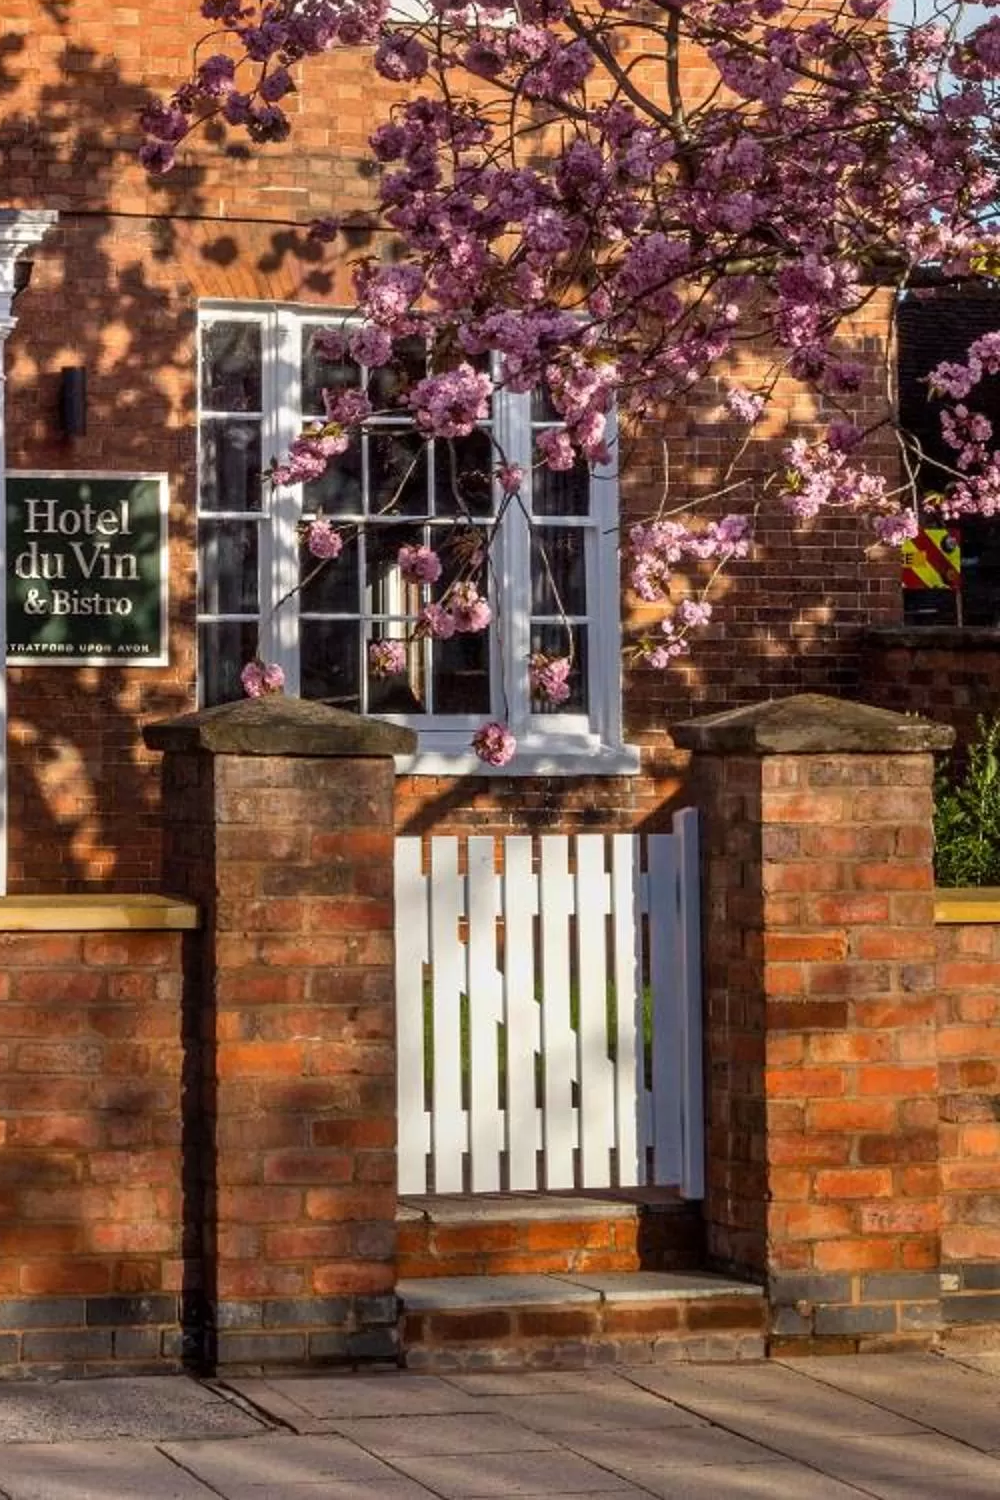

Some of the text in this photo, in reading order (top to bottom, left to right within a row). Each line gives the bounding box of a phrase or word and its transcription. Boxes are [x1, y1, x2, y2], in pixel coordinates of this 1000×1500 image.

[23, 498, 132, 535] Hotel
[15, 541, 140, 581] du Vin
[23, 587, 133, 616] & Bistro
[6, 642, 149, 653] TRATFORD UPON AVON
